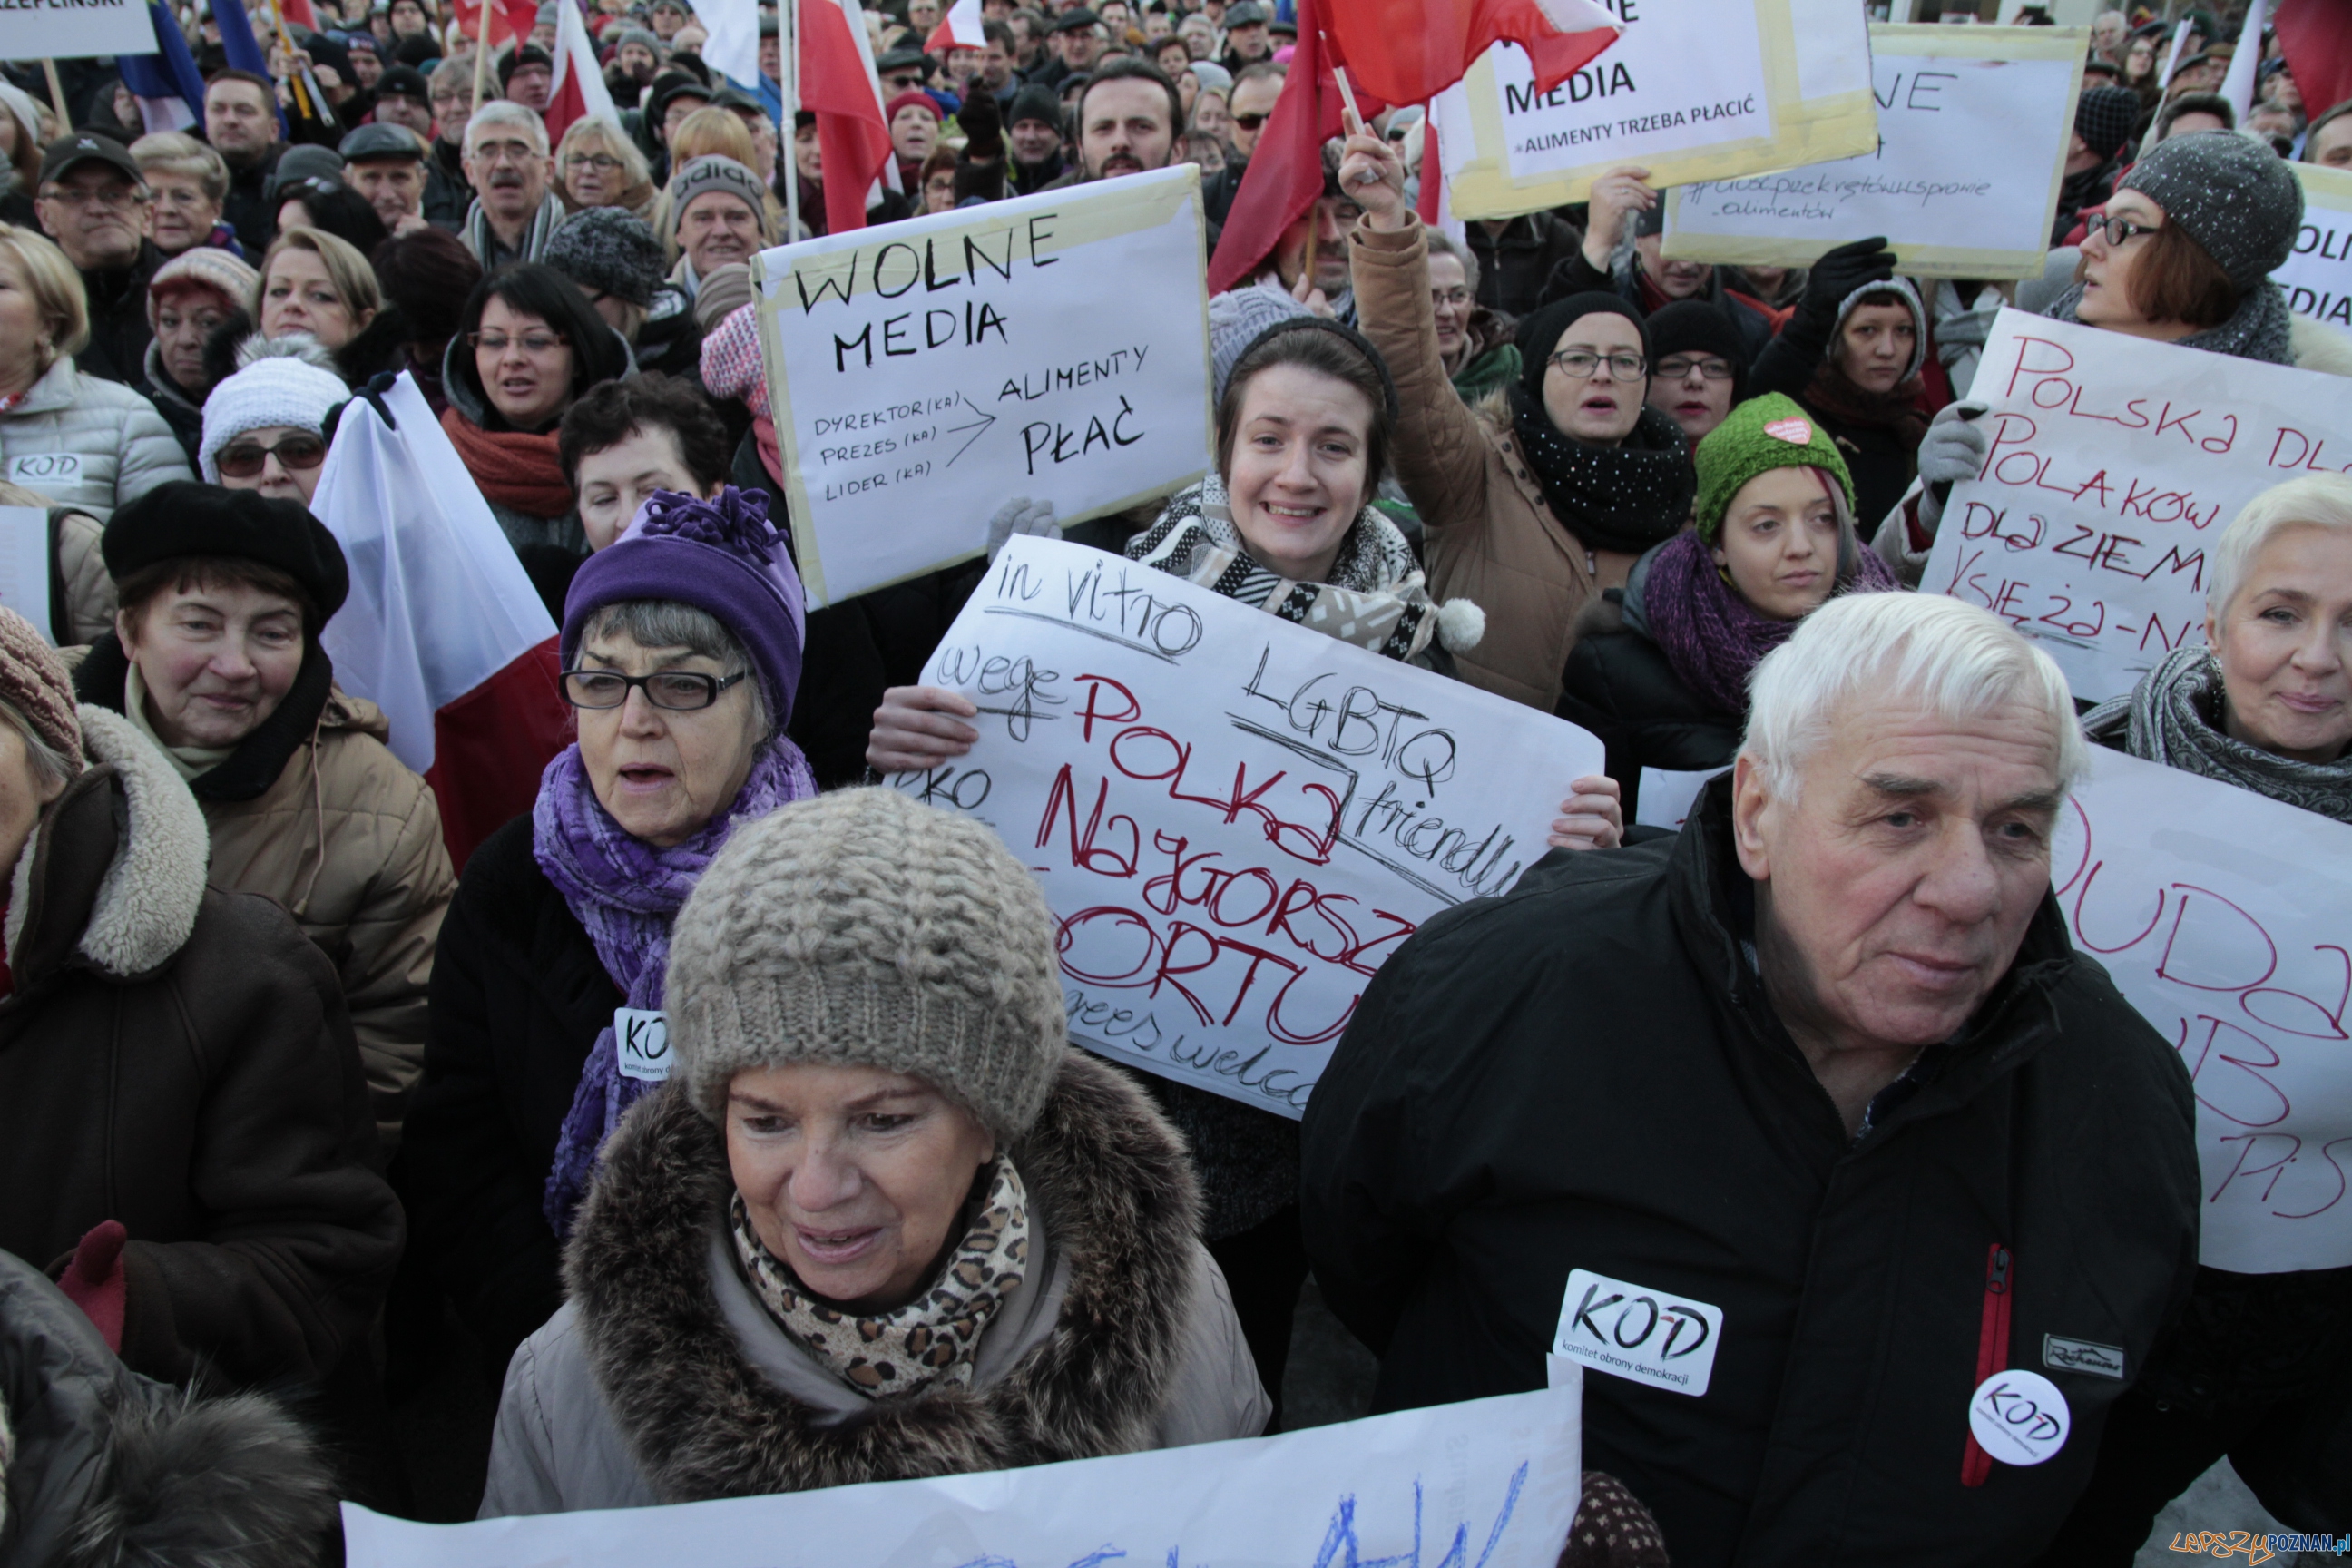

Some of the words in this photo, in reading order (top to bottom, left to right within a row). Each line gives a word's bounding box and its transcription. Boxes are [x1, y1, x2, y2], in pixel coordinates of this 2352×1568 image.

[1505, 62, 1636, 115] MEDIA
[1618, 111, 1686, 137] TRZEBA
[1691, 93, 1755, 124] PŁACIĆ
[794, 212, 1060, 317] WOLNE
[833, 299, 1009, 373] MEDIA
[998, 344, 1149, 402] ALIMENTY
[819, 438, 897, 466] PREZES
[904, 426, 936, 447] (KA)
[1020, 394, 1145, 475] PŁAĆ
[15, 455, 78, 477] KOD
[826, 473, 888, 502] LIDER
[896, 460, 931, 484] (KA)
[997, 554, 1043, 601] in
[1241, 641, 1456, 798] LGBTQ
[1572, 1282, 1710, 1362] KOD
[1562, 1339, 1598, 1359] komitet
[1600, 1352, 1633, 1371] obrony
[1634, 1361, 1690, 1386] demokracji
[1984, 1382, 2061, 1441] KOD
